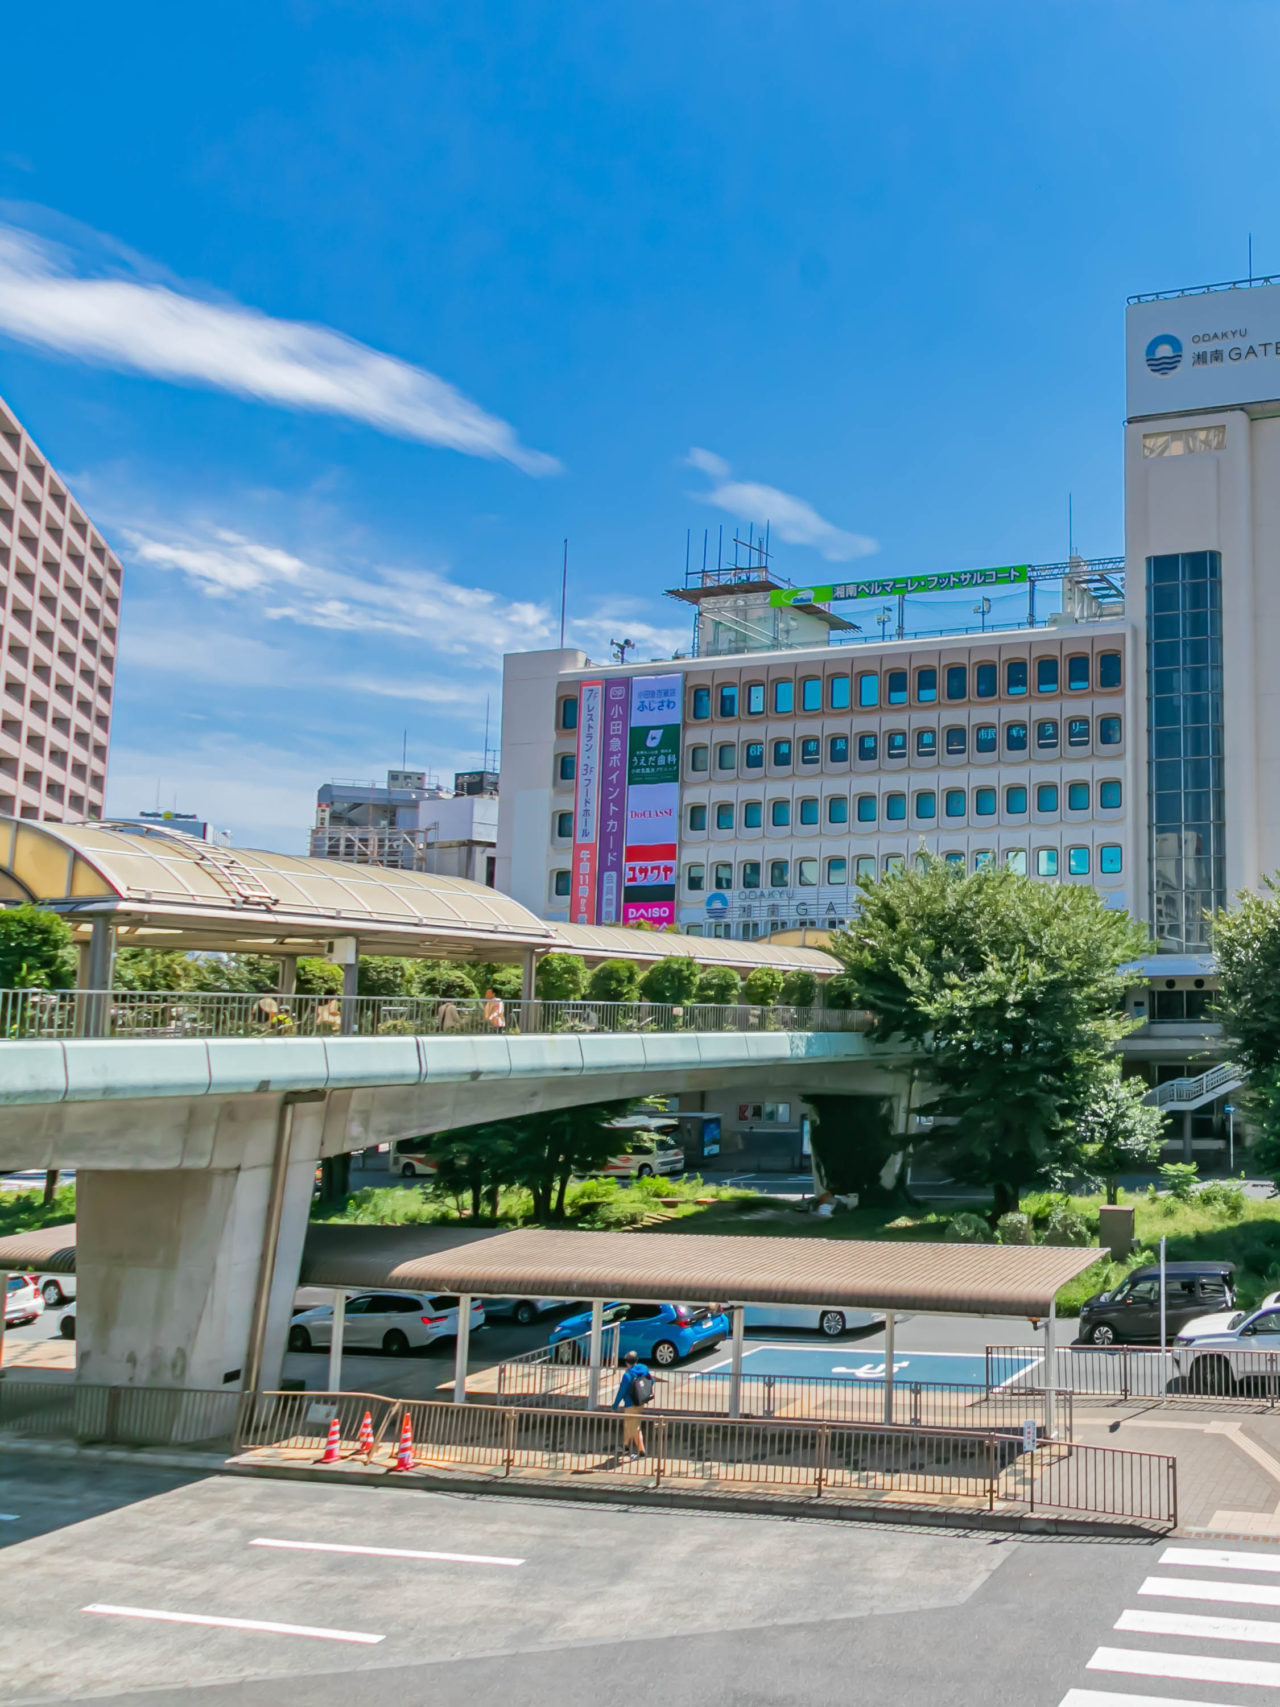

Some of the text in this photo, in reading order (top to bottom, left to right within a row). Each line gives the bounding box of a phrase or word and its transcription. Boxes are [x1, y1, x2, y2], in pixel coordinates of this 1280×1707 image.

[1191, 327, 1248, 344] ODAKYU
[832, 567, 1021, 600] 湘南ベルマーレ・フットサルコート
[637, 699, 677, 712] ふじさわ
[749, 744, 764, 757] 6F
[977, 721, 1089, 740] 市民ギャラリー
[632, 753, 677, 767] うえだ歯科
[606, 703, 624, 867] 小田急ポイントカード
[630, 808, 674, 818] DoCLASSE
[738, 889, 795, 901] ODAKYU
[628, 907, 670, 918] DAISO
